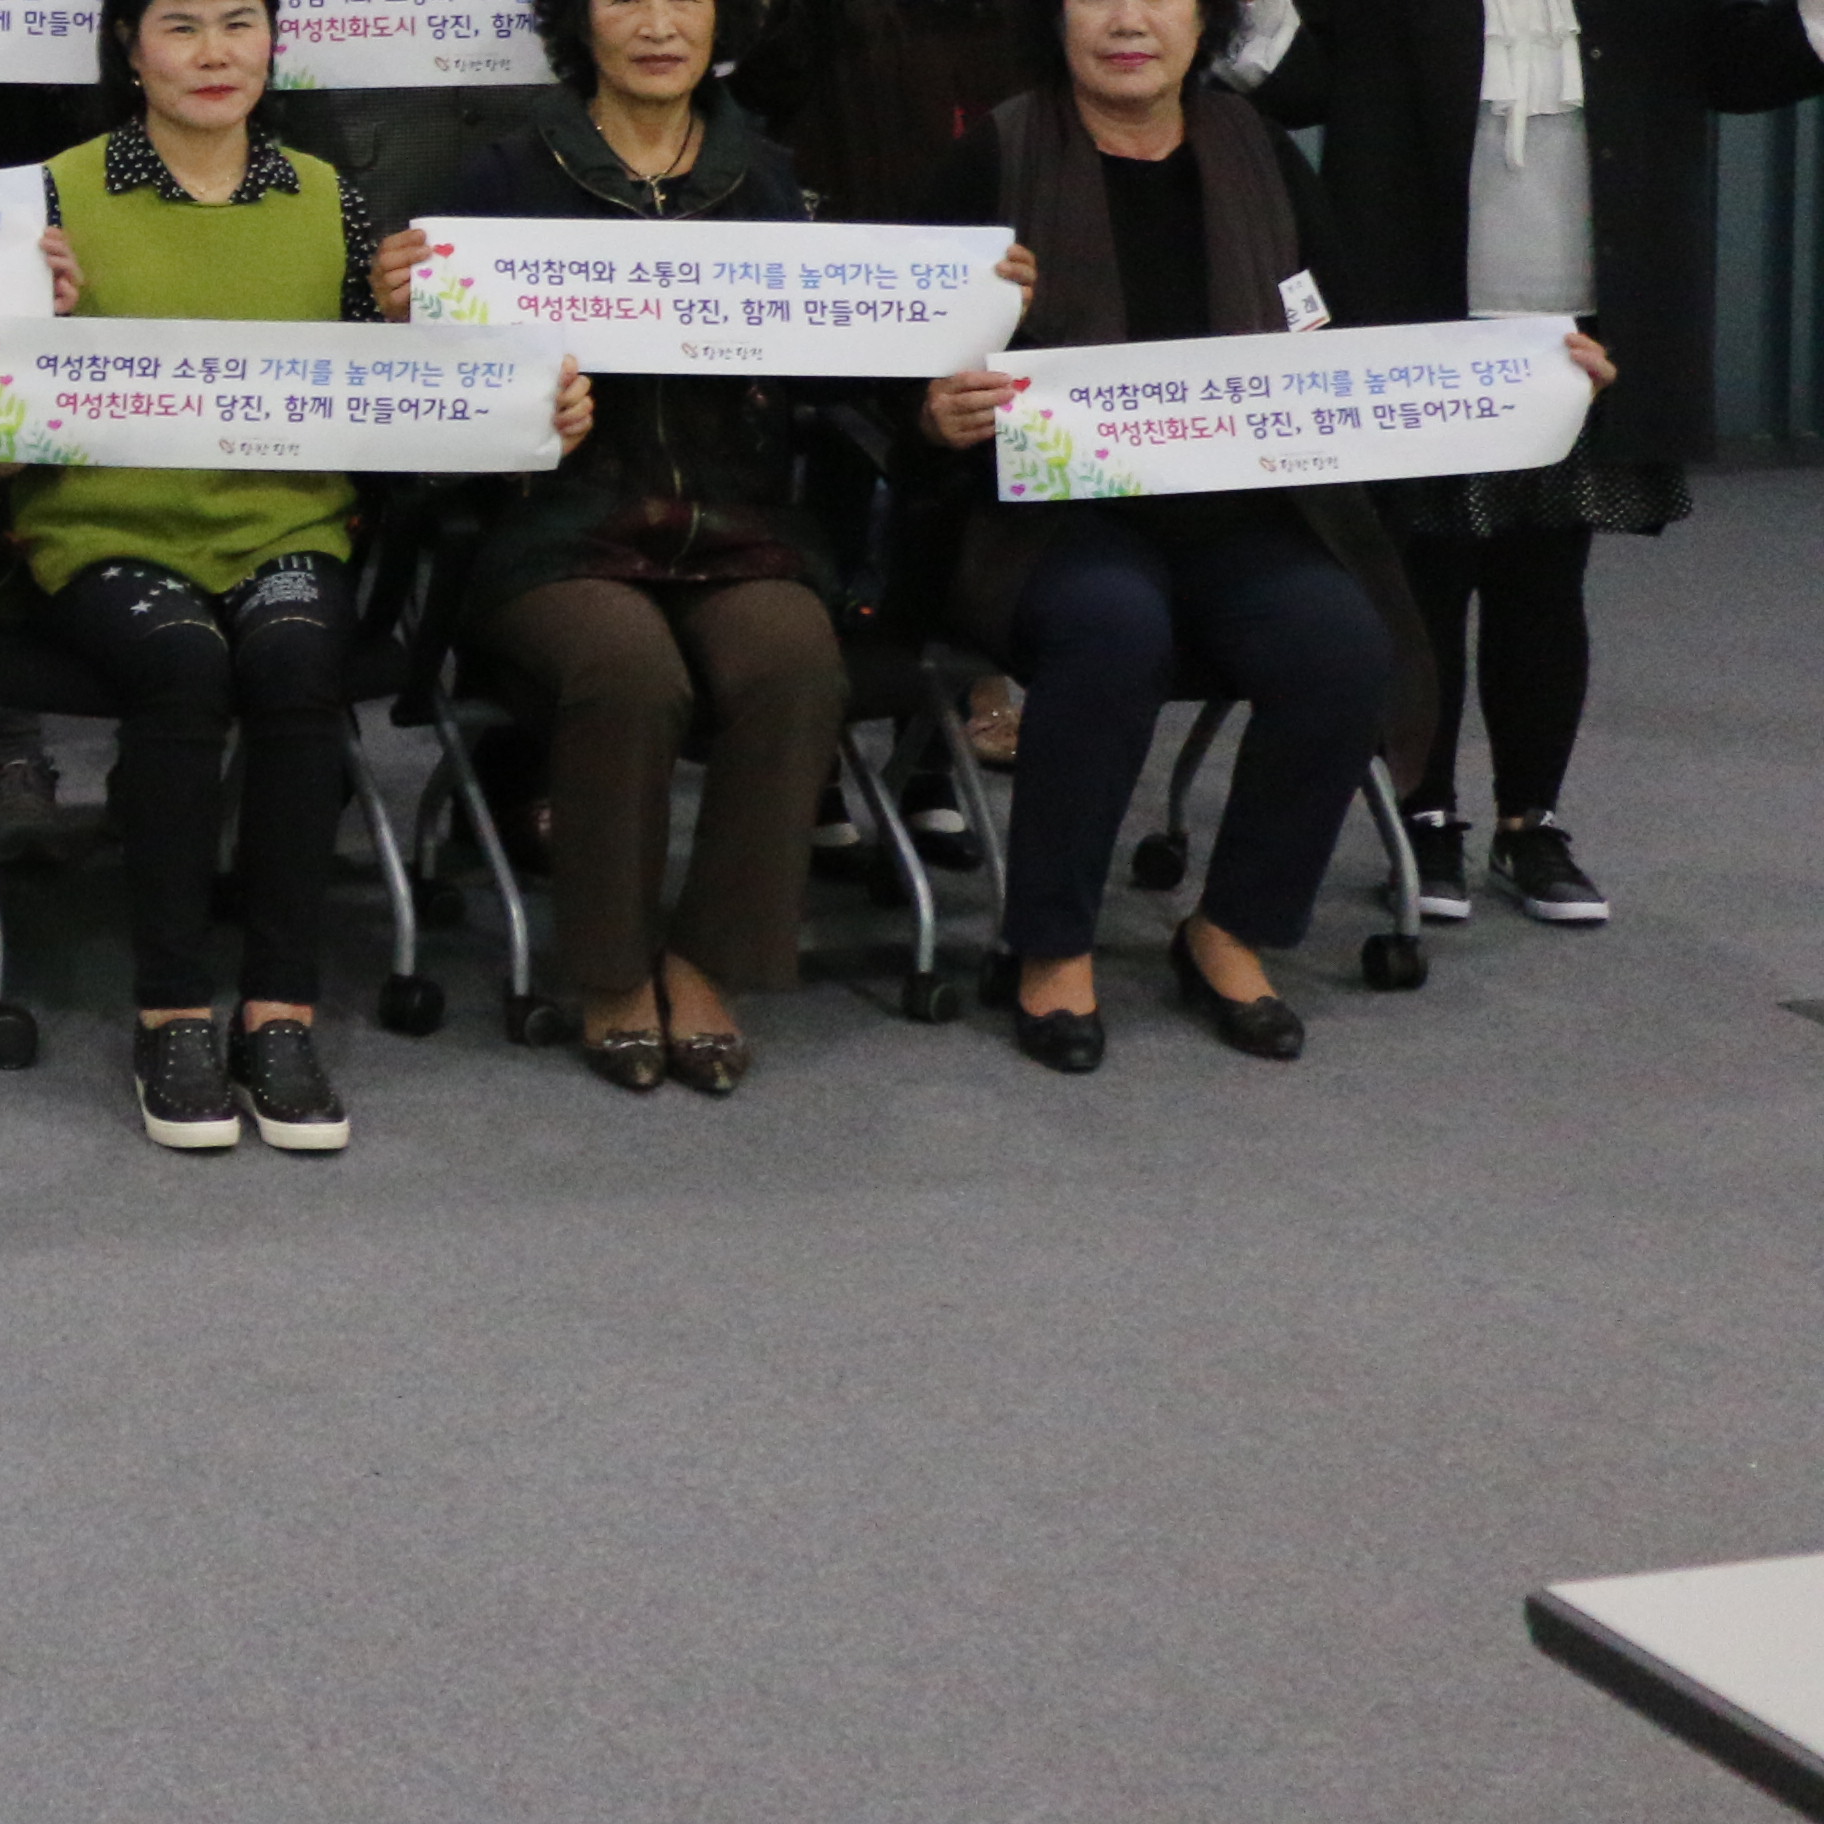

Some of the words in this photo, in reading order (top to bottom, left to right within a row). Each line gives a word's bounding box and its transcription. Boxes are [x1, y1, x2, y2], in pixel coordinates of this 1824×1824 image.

[493, 257, 618, 287] 여성참여와
[627, 260, 702, 289] 소통의
[713, 261, 787, 291] 가치를
[798, 262, 898, 290] 높여가는
[909, 262, 969, 291] 당진!
[516, 294, 662, 323] 여성친화도시
[672, 298, 730, 326] 당진,
[740, 297, 792, 327] 함께
[803, 299, 948, 328] 만들어가요~
[35, 353, 163, 383] 여성참여와
[171, 356, 248, 385] 소통의
[259, 357, 333, 387] 가치를
[345, 360, 444, 388] 높여가는
[456, 361, 515, 389] 당진!
[1068, 379, 1190, 413] 여성참여와
[1199, 374, 1272, 405] 소통의
[1281, 369, 1354, 398] 가치를
[1364, 364, 1461, 396] 높여가는
[1470, 357, 1531, 387] 당진!
[55, 391, 204, 421] 여성친화도시
[214, 393, 271, 423] 당진,
[284, 394, 334, 424] 함께
[346, 396, 490, 425] 만들어가요~
[1096, 414, 1237, 448] 여성친화도시
[1245, 410, 1303, 441] 당진,
[1311, 406, 1363, 436] 함께
[1371, 395, 1516, 431] 만들어가요~
